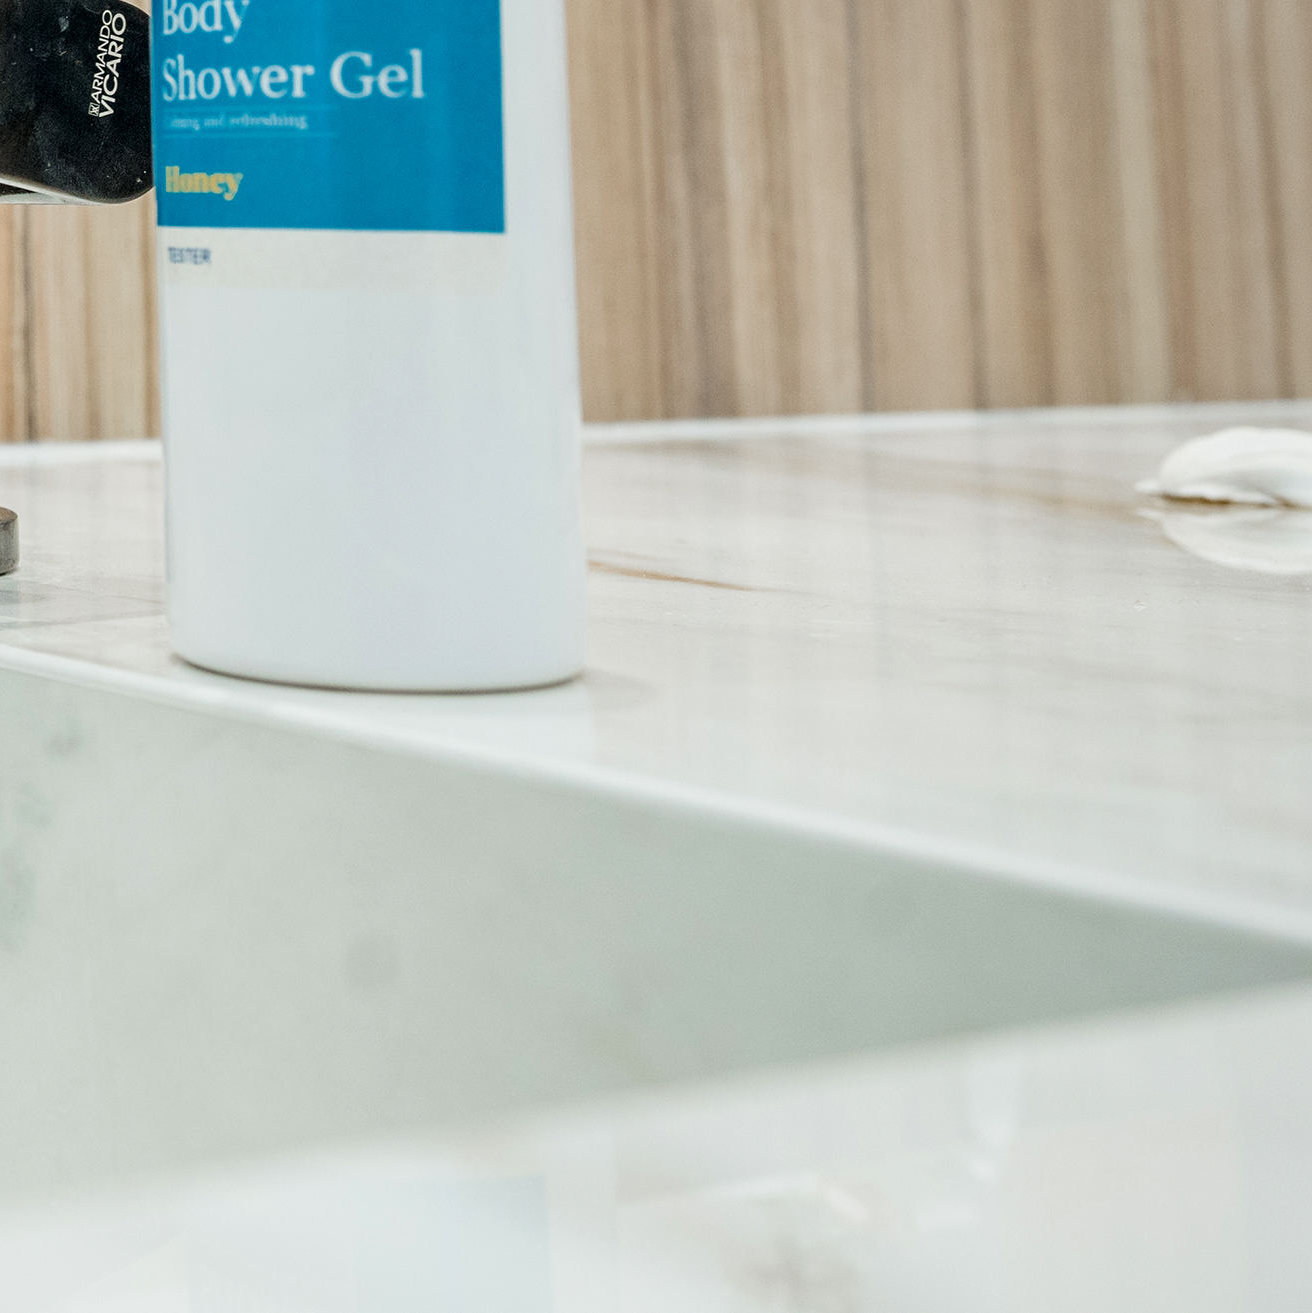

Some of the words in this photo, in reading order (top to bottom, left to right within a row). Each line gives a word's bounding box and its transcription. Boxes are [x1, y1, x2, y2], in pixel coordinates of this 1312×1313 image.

[91, 9, 113, 104] ARMANDO
[99, 13, 127, 118] VICARIO
[162, 54, 315, 101] Shower
[330, 49, 425, 99] Gel
[165, 165, 244, 201] Honey
